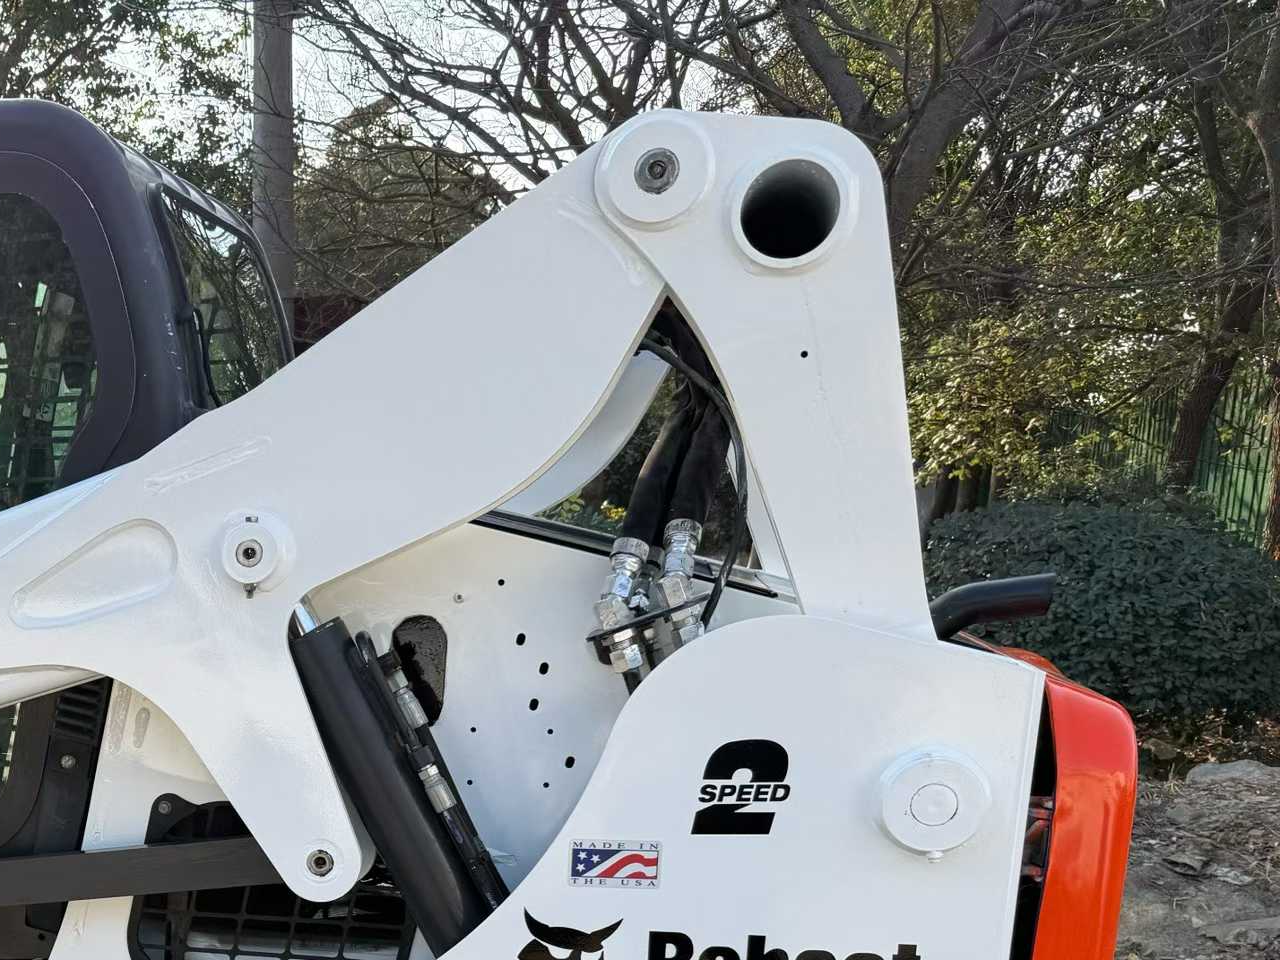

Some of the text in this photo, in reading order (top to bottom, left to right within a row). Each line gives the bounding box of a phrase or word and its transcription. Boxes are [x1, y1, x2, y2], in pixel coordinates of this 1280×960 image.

[691, 738, 791, 835] 2 SPEED
[572, 841, 626, 849] MADE
[620, 879, 656, 887] USA
